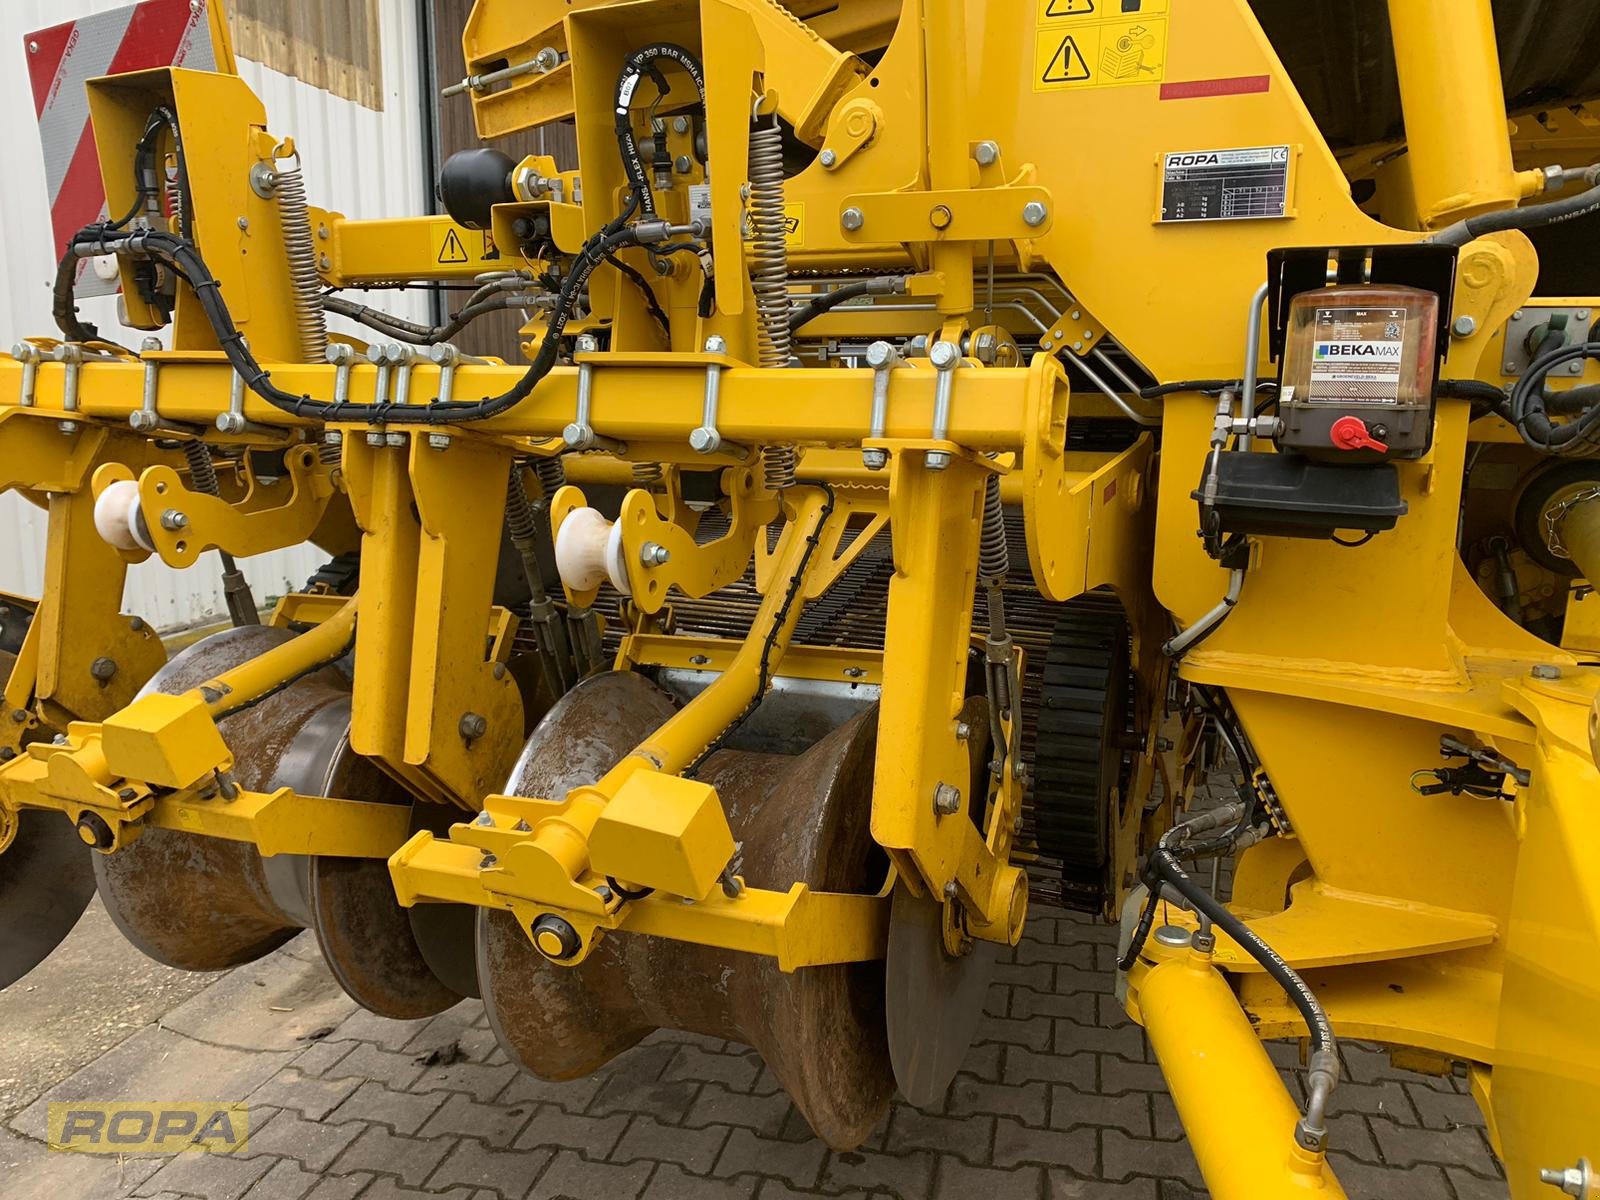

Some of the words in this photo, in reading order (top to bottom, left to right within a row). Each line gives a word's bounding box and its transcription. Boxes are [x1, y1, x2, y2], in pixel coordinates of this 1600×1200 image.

[631, 157, 652, 212] HANS-FLEX
[644, 47, 658, 58] 350
[661, 47, 679, 58] BAR
[679, 55, 698, 77] MSHA
[1168, 154, 1218, 167] ROPA
